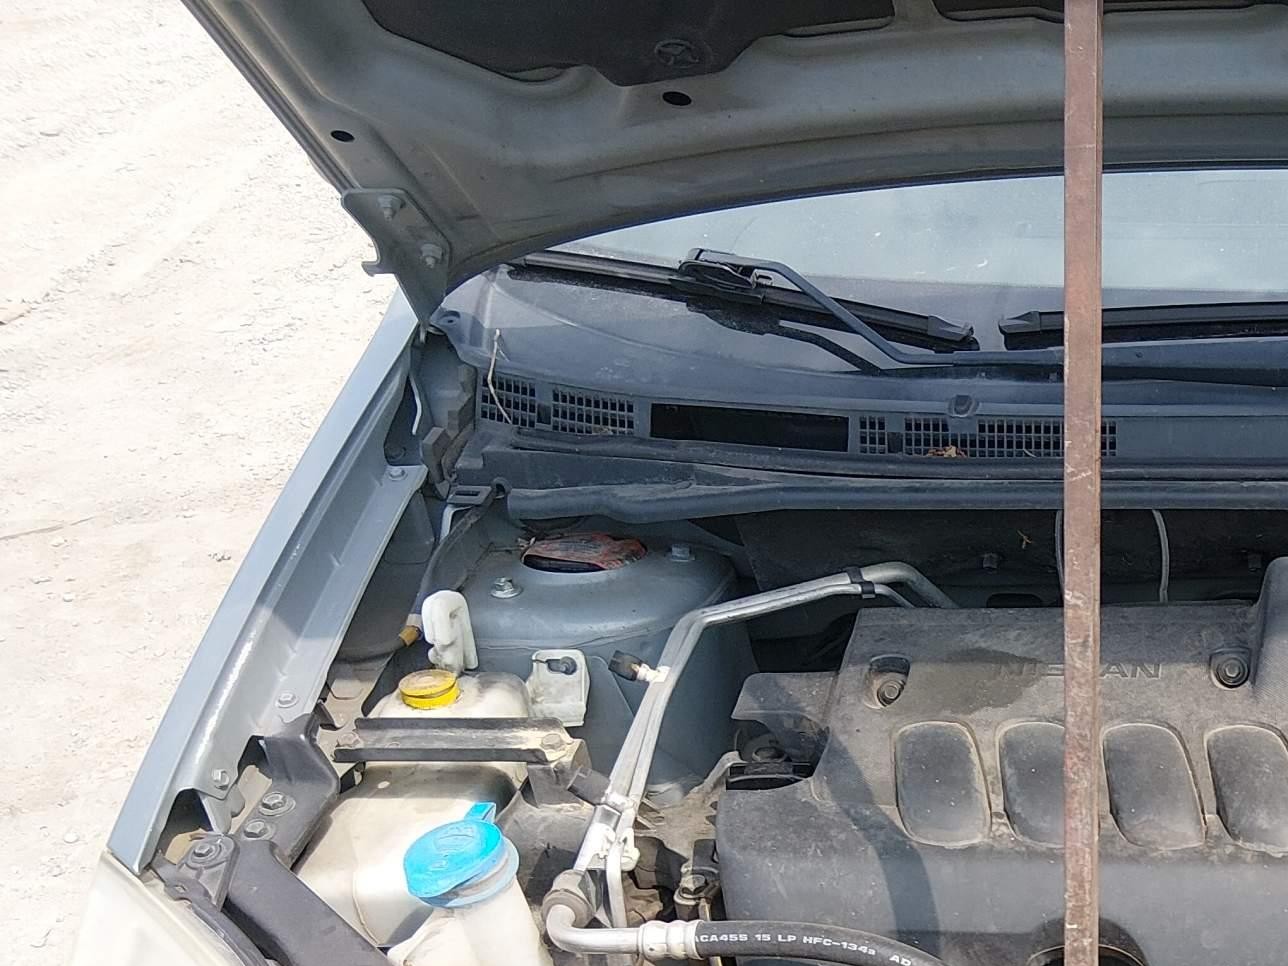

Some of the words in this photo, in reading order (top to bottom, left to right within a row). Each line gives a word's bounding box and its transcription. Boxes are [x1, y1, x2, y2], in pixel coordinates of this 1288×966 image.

[1001, 662, 1162, 679] NISAN
[755, 934, 771, 942] 15
[777, 935, 797, 943] LP
[802, 936, 876, 956] HFC-134a
[889, 954, 912, 966] AD
